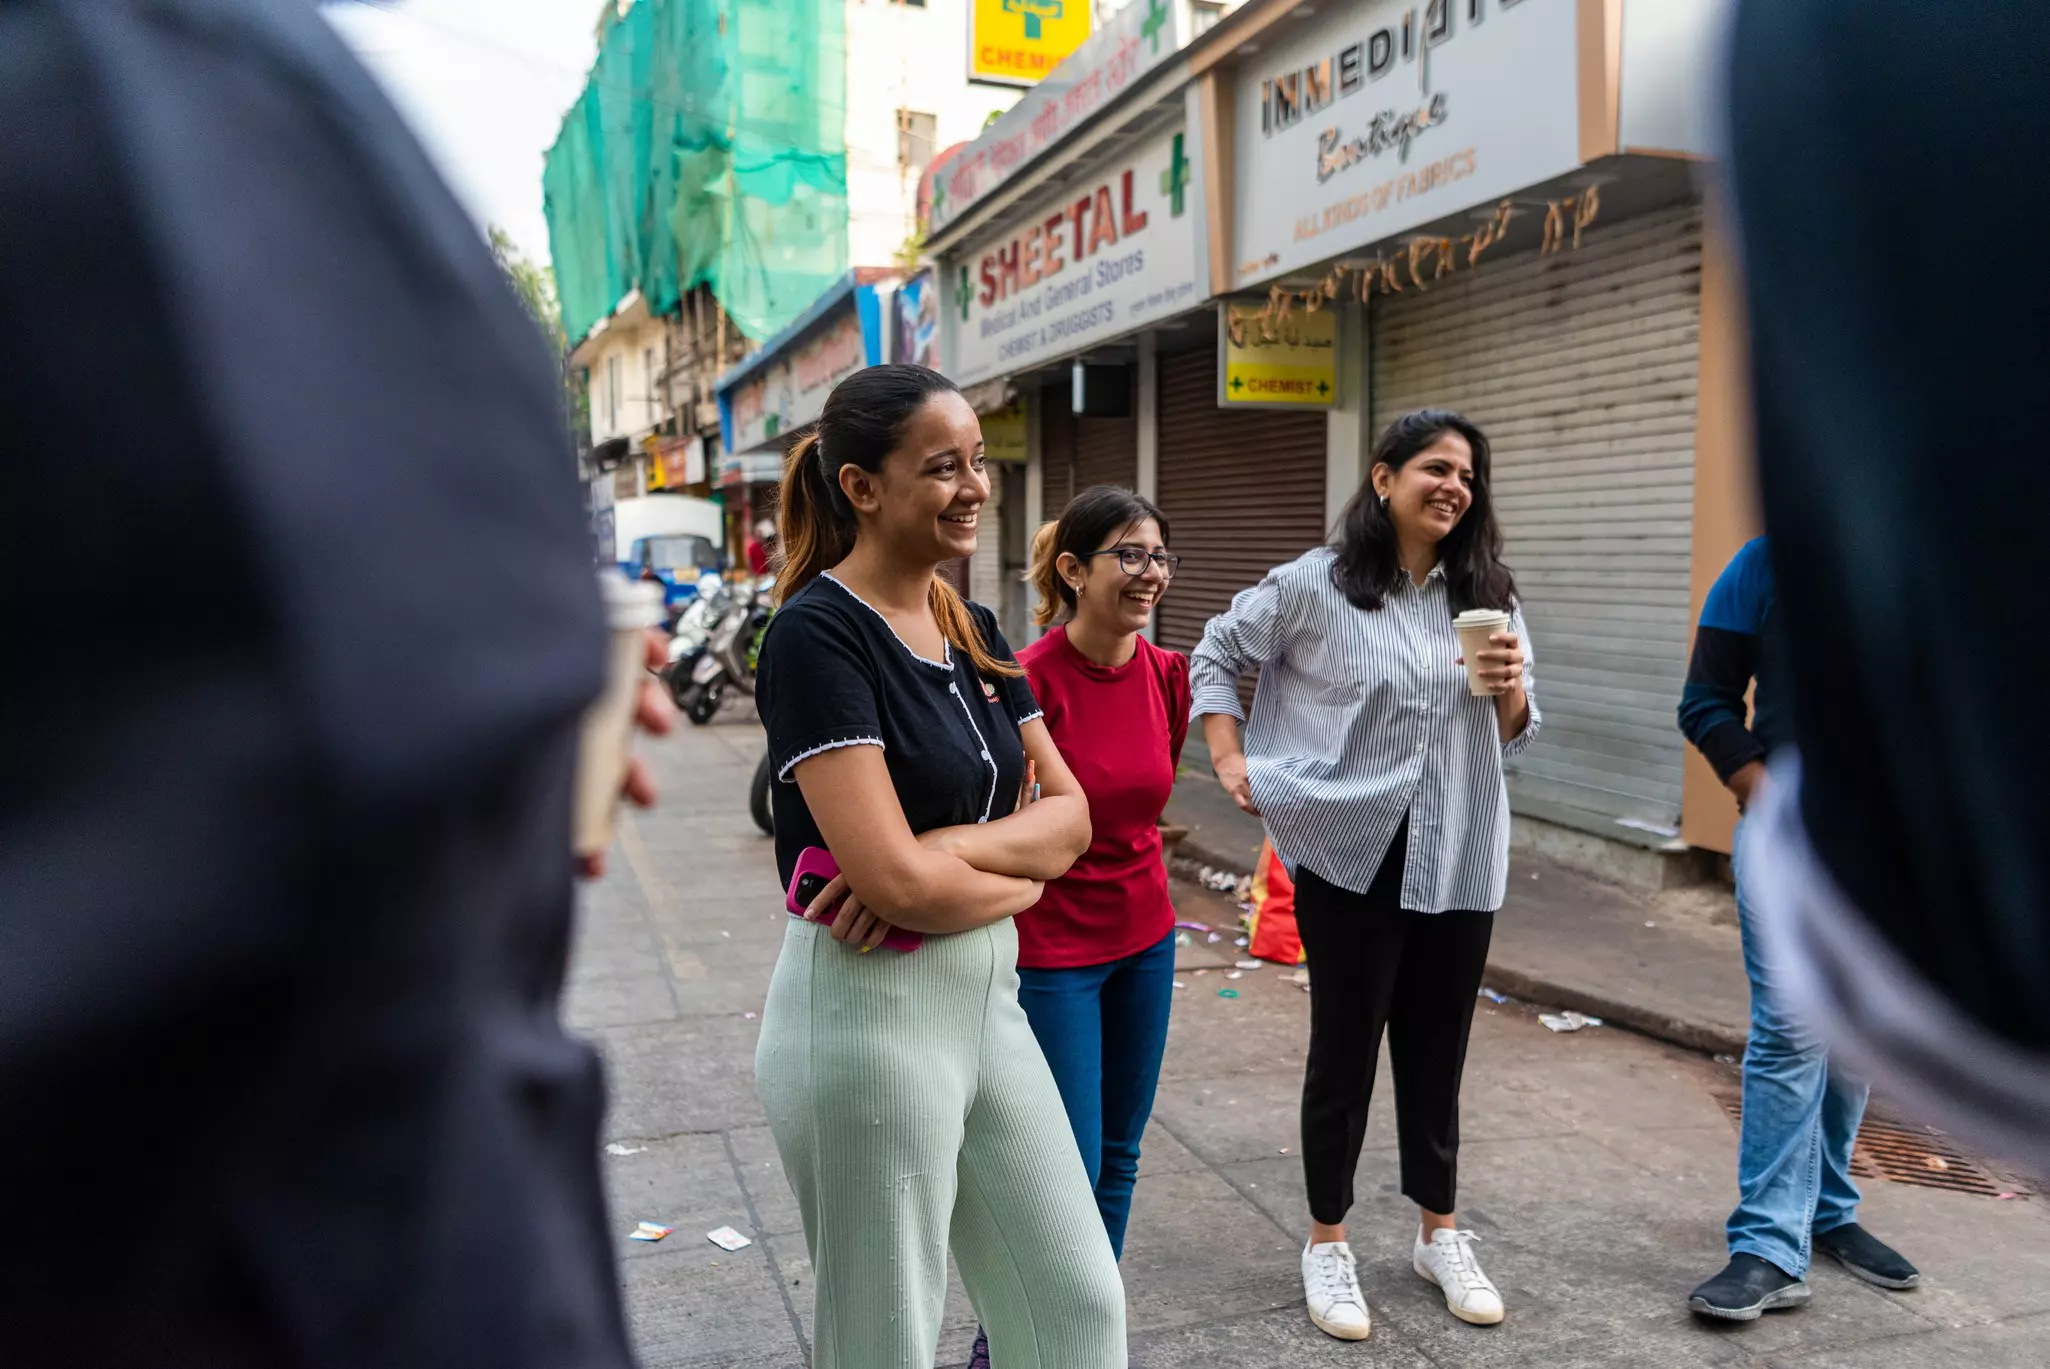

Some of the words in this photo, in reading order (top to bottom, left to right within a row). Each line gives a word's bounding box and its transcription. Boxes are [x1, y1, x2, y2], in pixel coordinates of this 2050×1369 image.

[1261, 0, 1527, 136] IMMEDIA
[1396, 145, 1477, 203] FABRICS
[980, 169, 1148, 308] SHEETAL
[1045, 267, 1093, 313] General
[1096, 249, 1145, 288] Stores
[1246, 377, 1313, 394] CHEMIST
